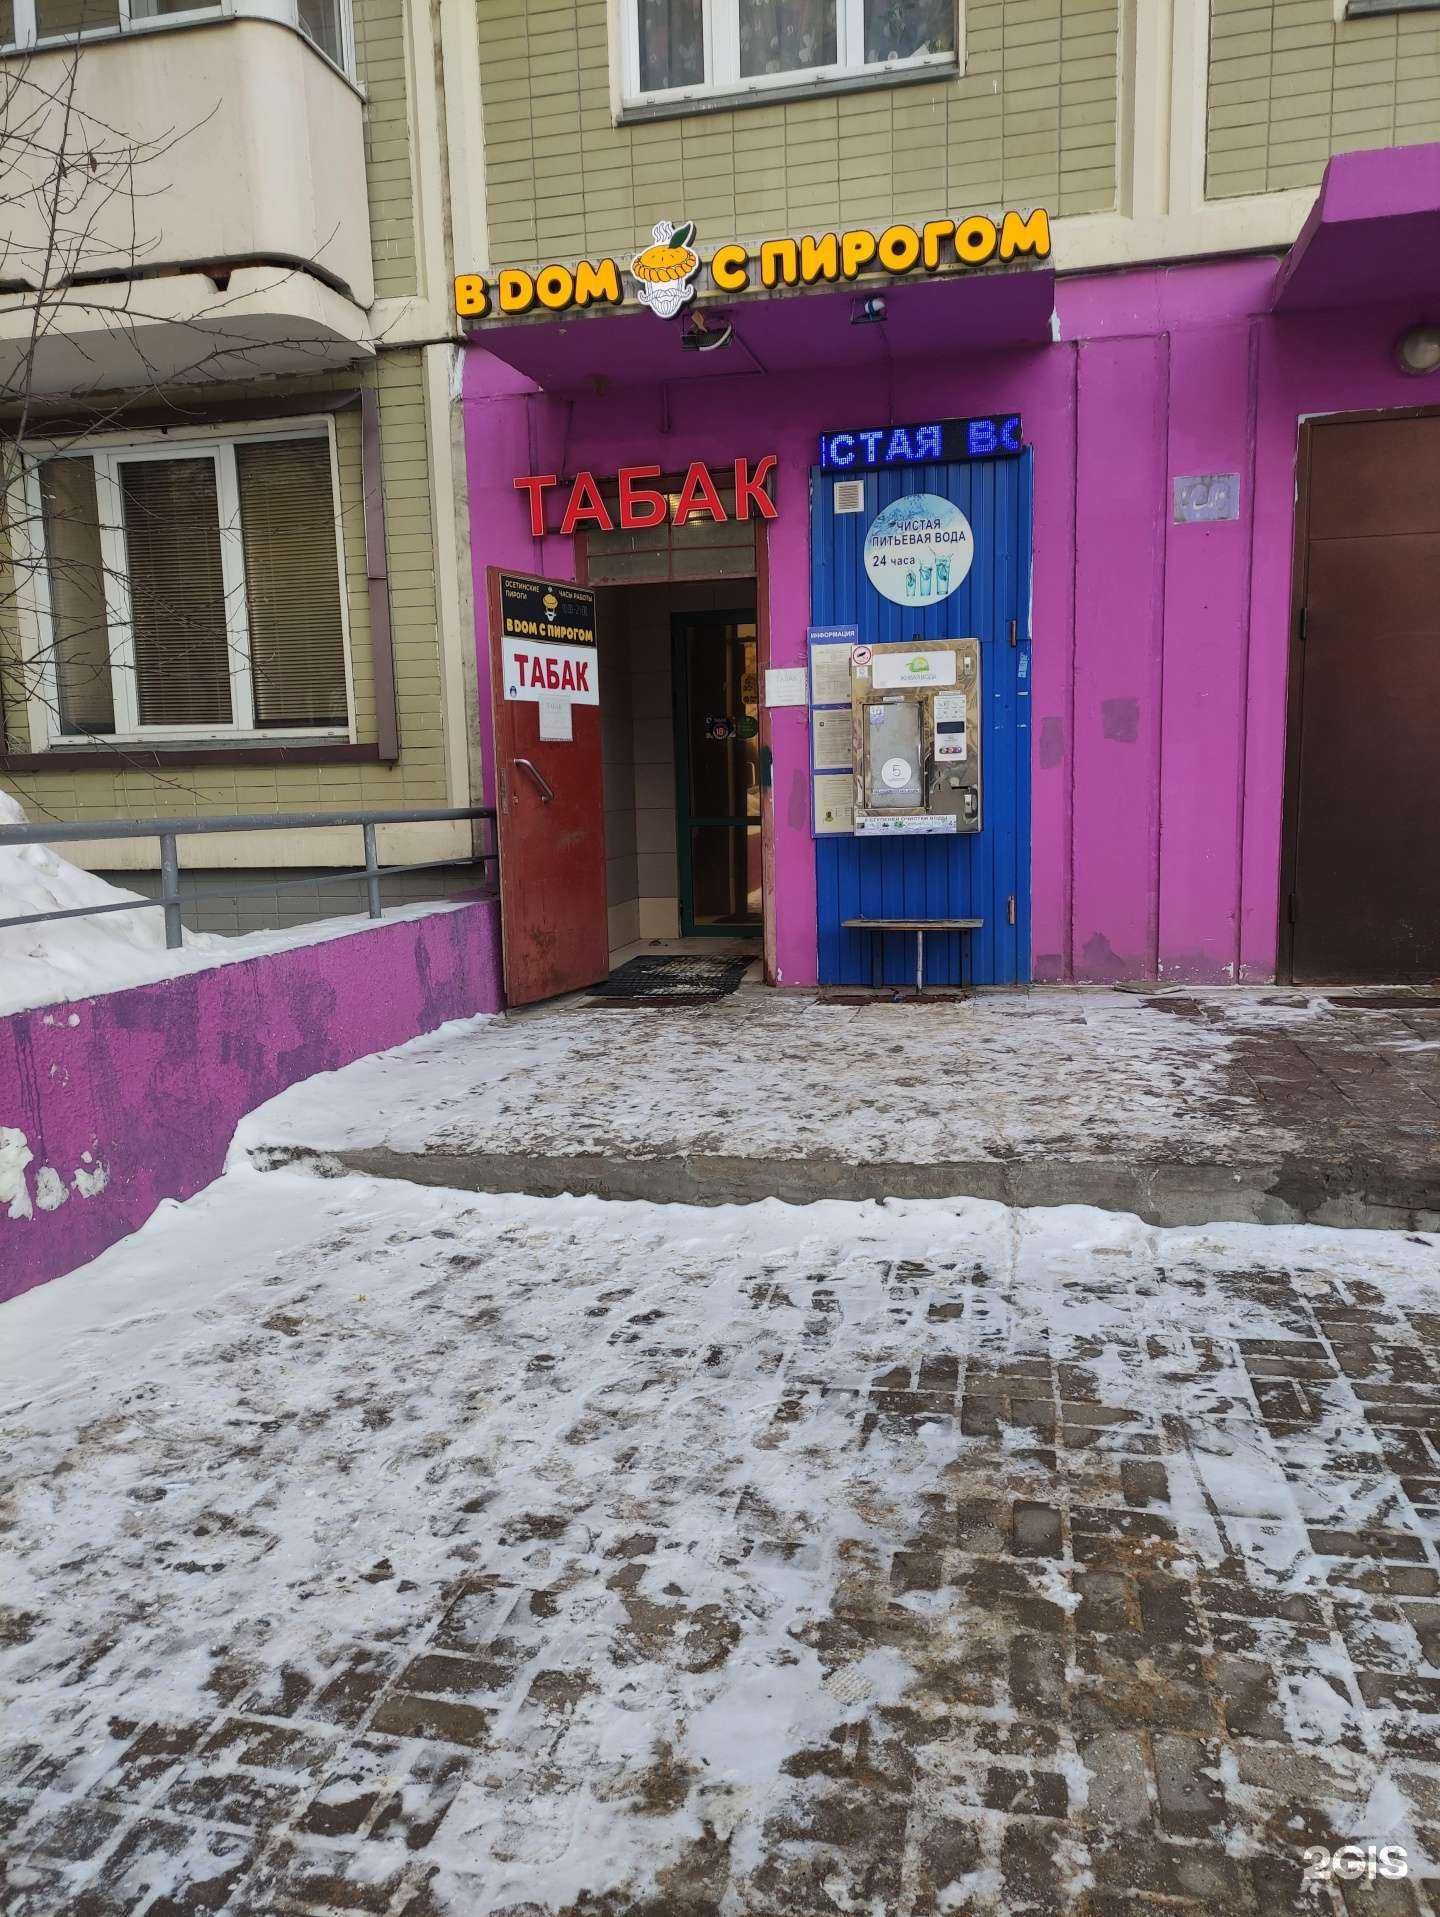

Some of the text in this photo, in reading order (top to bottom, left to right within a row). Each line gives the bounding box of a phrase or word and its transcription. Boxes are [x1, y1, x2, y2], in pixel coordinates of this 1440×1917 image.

[760, 208, 1053, 290] ПИРОГОМ
[822, 425, 943, 468] СТАЯ
[514, 455, 779, 537] ТАБАК
[896, 518, 941, 532] ЧИСТАЯ
[872, 530, 966, 548] ПИТЬЕВАЯ ВОДА
[872, 555, 915, 567] 24 часа
[504, 580, 540, 593] ОСЕТИНСКИЕ
[505, 590, 528, 600] ПИРОГИ
[559, 590, 593, 602] ЧАСЫ РАБОТЫ
[547, 624, 593, 642] ПИРОГОМ
[810, 630, 855, 639] ИНФОРМАЦИЯ
[513, 653, 590, 692] ТАБАК
